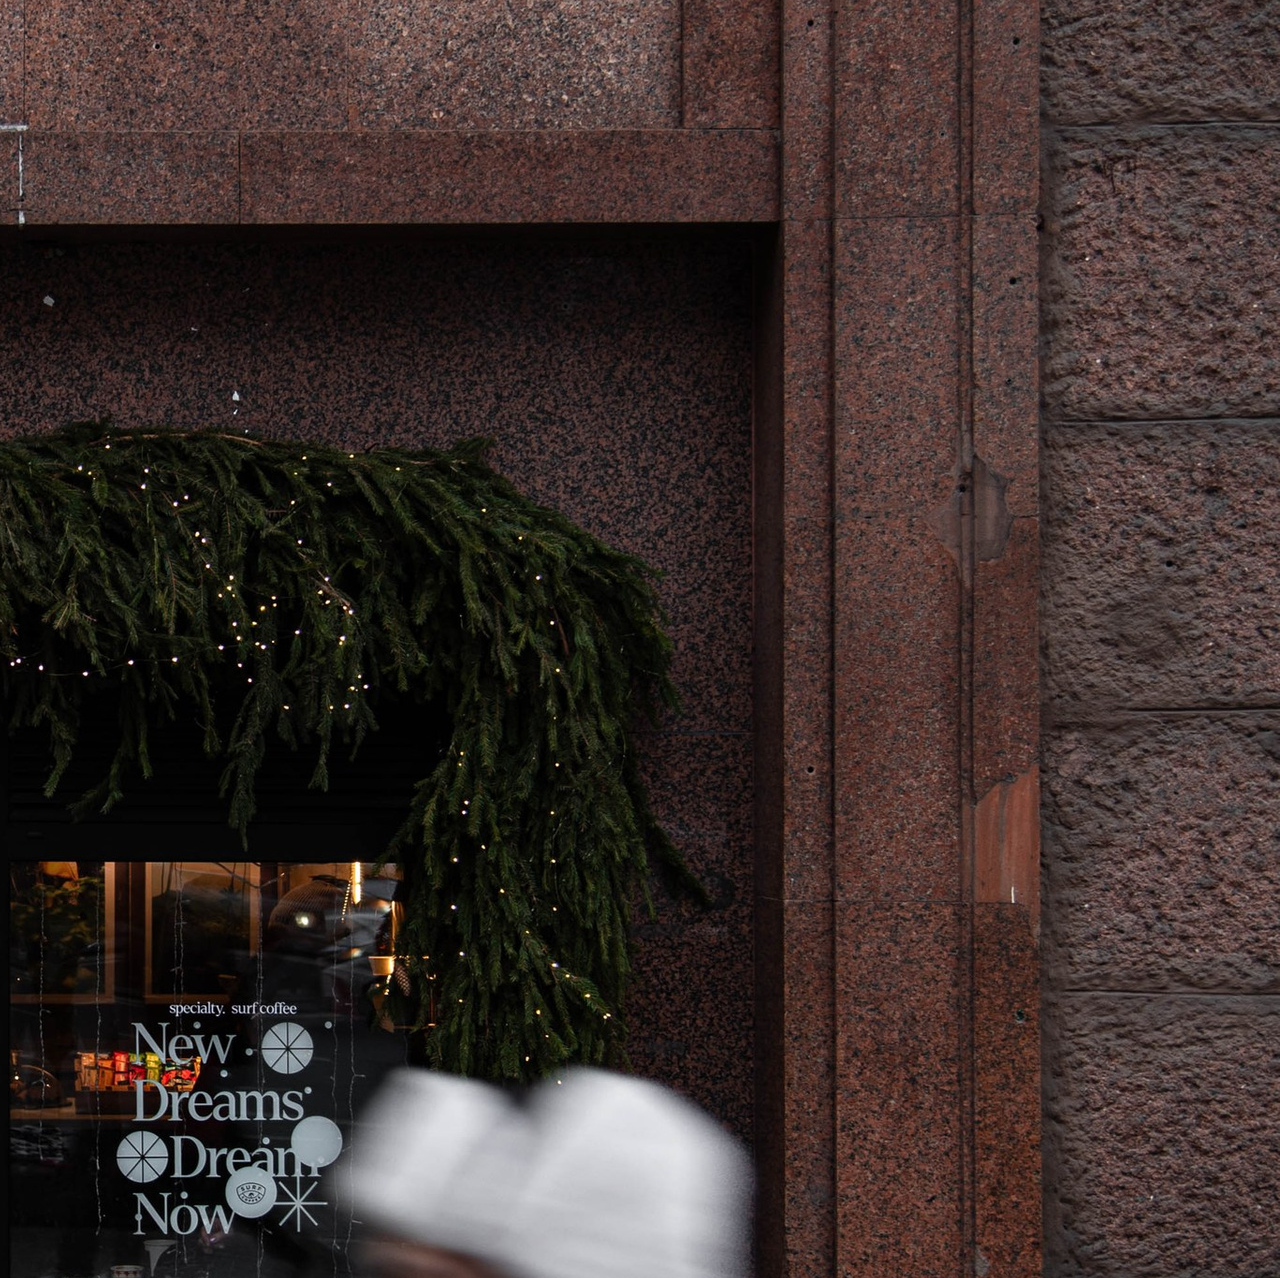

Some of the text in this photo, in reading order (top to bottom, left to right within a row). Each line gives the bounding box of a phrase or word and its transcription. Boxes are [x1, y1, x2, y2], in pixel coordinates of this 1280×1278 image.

[169, 1001, 297, 1016] specialty. surf coffee
[131, 1022, 237, 1065] New
[131, 1079, 304, 1122] Dreams
[132, 1192, 236, 1236] Now
